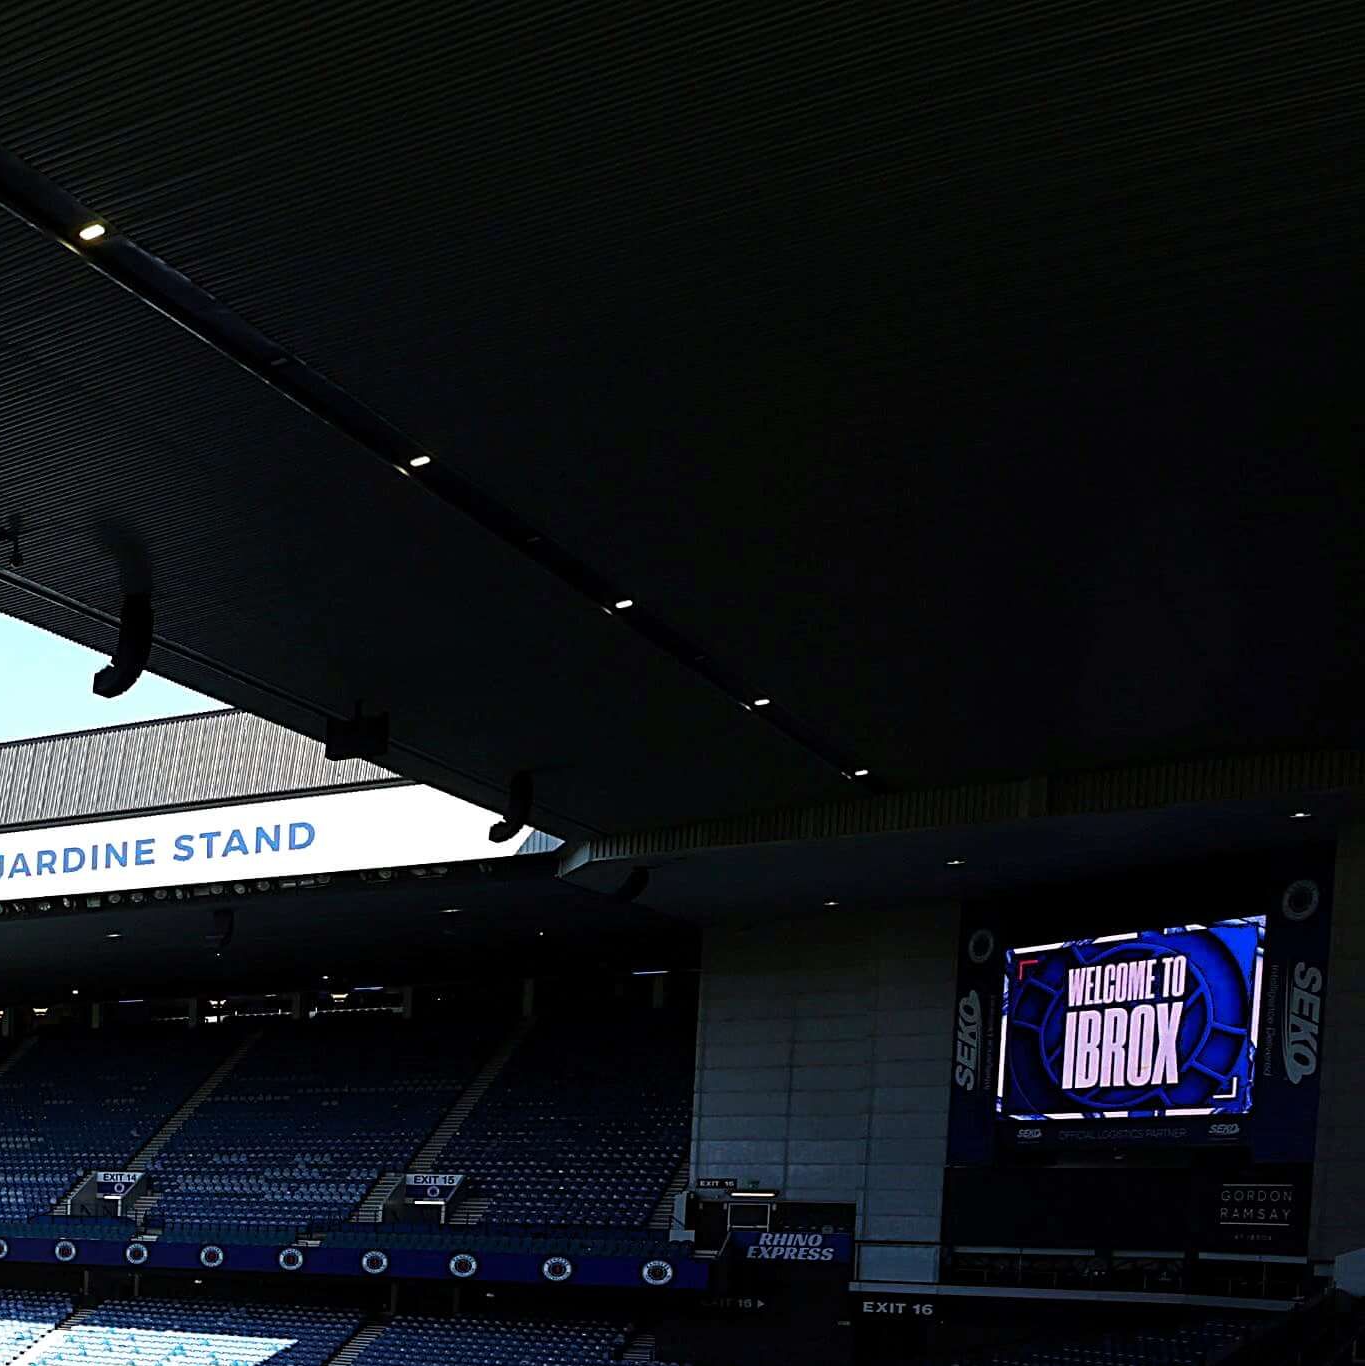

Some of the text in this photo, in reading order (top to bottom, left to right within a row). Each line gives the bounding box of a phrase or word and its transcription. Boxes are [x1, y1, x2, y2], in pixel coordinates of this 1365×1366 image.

[172, 821, 316, 863] STAND
[1067, 954, 1188, 1008] WELCOME TO
[1285, 961, 1323, 1085] SEKO
[954, 989, 985, 1092] SEKO
[1061, 1000, 1185, 1092] IBROX
[103, 1173, 137, 1182] EXIT 14
[413, 1174, 455, 1185] EXIT 15
[700, 1180, 719, 1188] EXIT
[1221, 1190, 1293, 1202] GORDON
[1220, 1207, 1291, 1221] RAMSAY
[759, 1232, 824, 1246] RHINO
[746, 1246, 836, 1261] EXPRESS
[862, 1301, 934, 1316] EXIT 16
